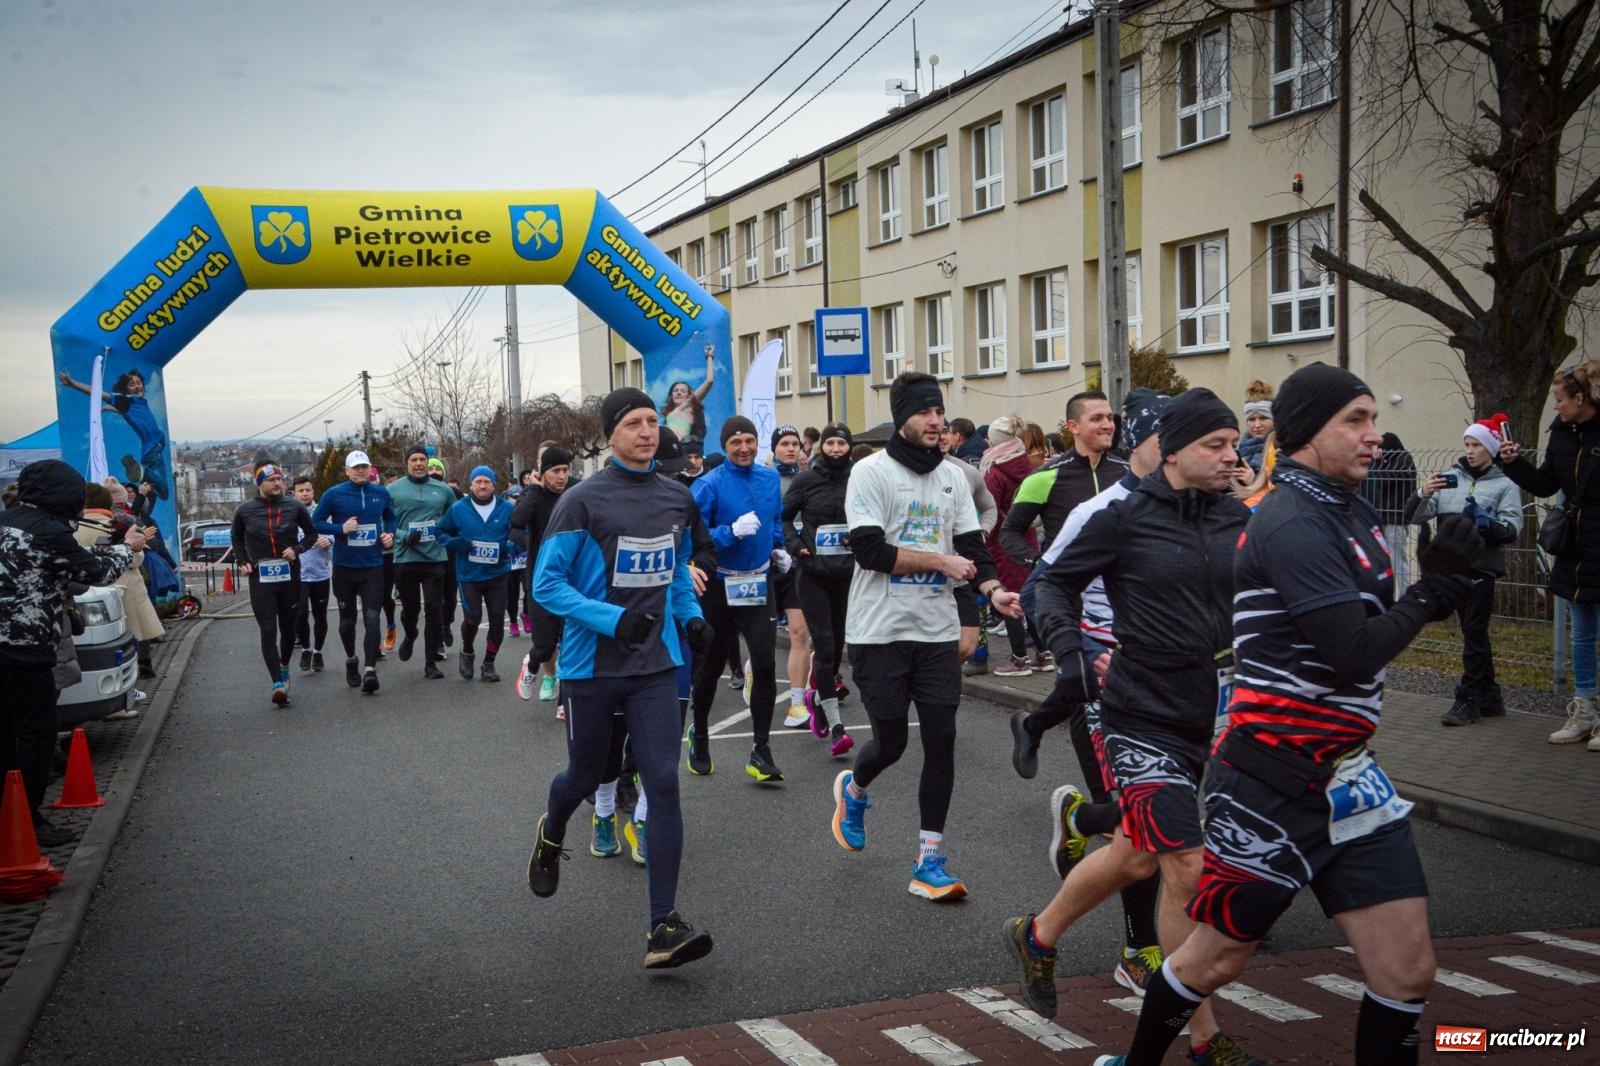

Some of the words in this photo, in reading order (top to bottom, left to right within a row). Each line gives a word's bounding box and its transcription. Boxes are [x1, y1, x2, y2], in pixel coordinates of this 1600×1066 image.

[359, 205, 463, 222] Gmina
[334, 225, 492, 246] Pietrowice
[355, 247, 472, 268] Wielkie
[98, 271, 164, 332] Gmina
[155, 224, 211, 279] ludzi
[601, 224, 656, 281] Gmina
[655, 274, 702, 320] ludzi
[127, 250, 231, 351] aktywnych
[585, 247, 682, 338] aktywnych
[356, 531, 369, 540] 27
[475, 548, 495, 557] 109
[629, 550, 667, 573] 111
[267, 565, 282, 576] 59
[739, 582, 758, 597] 94
[1348, 768, 1390, 814] 193
